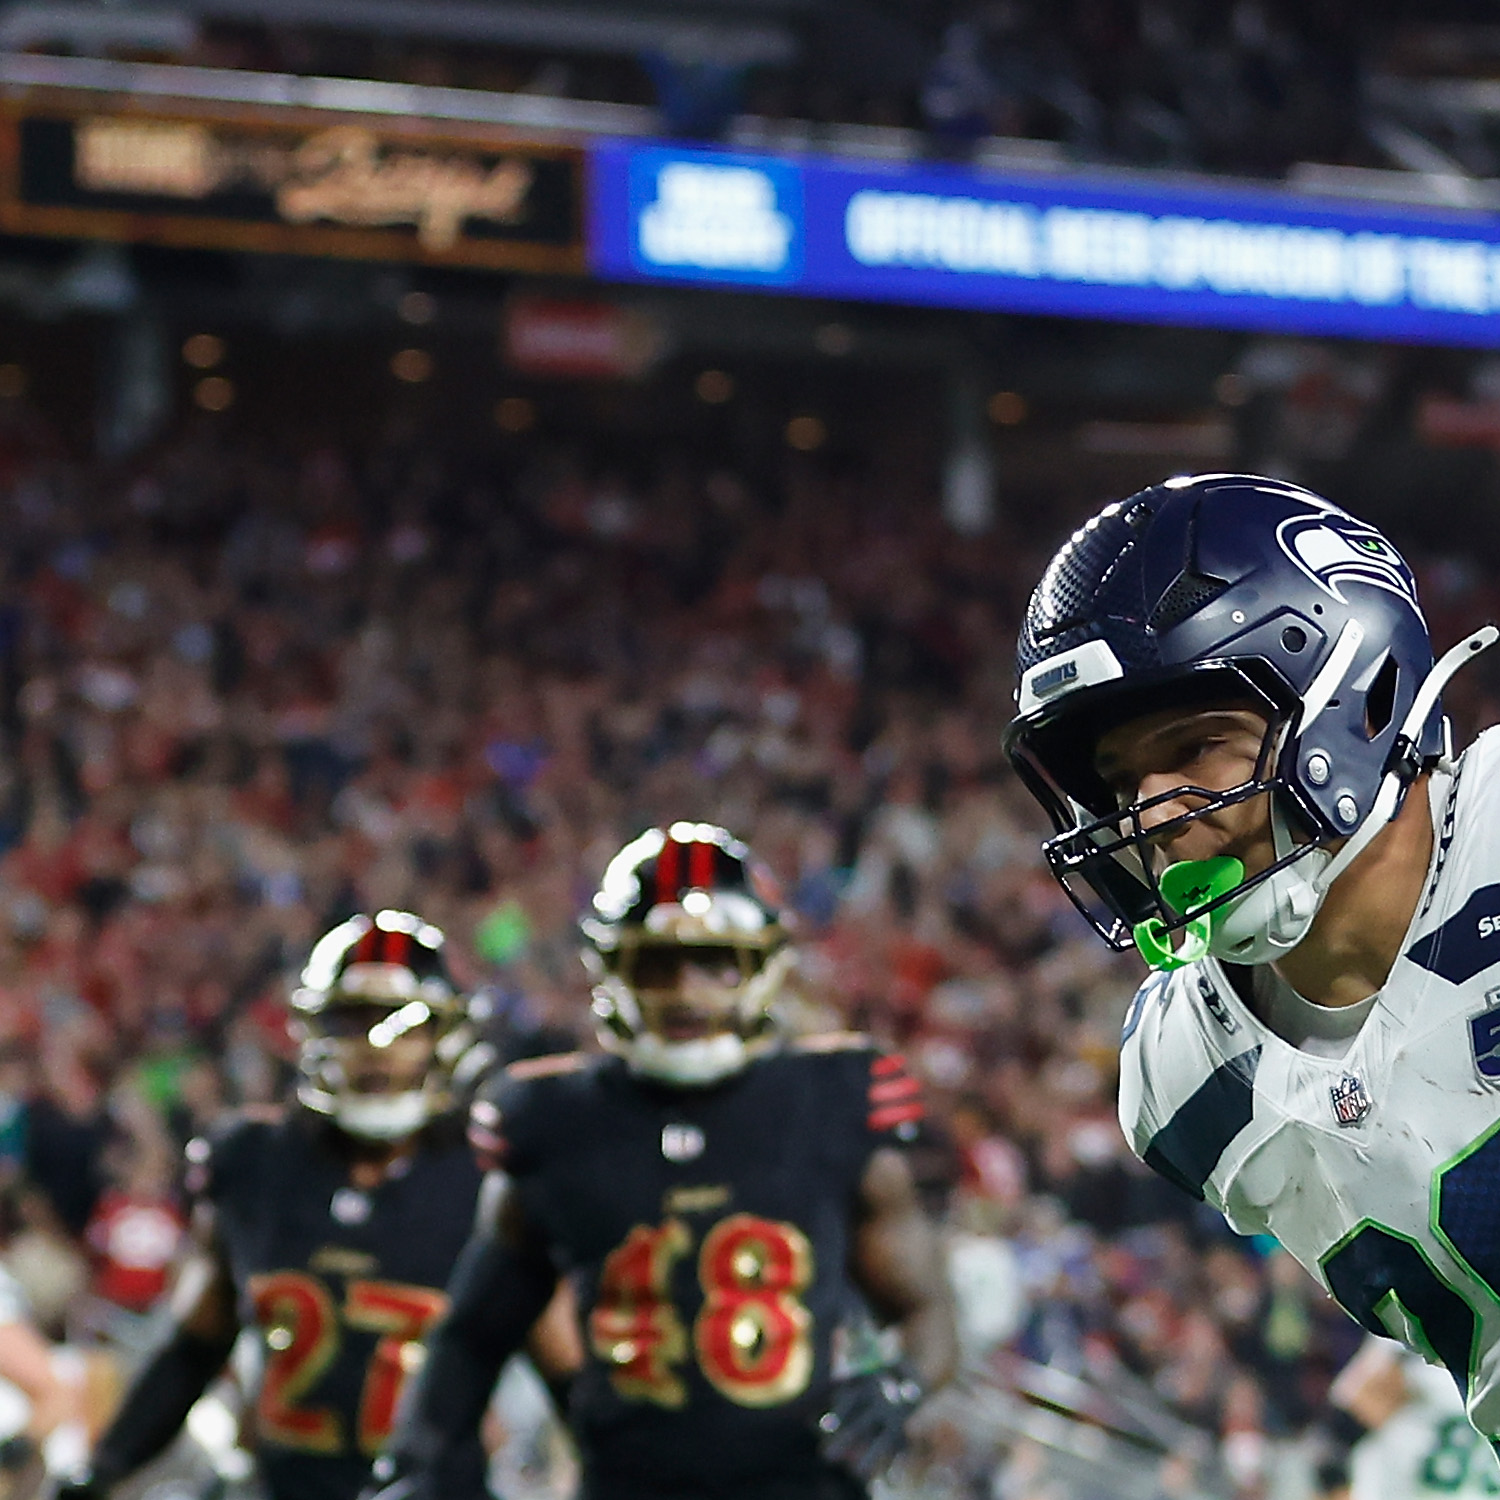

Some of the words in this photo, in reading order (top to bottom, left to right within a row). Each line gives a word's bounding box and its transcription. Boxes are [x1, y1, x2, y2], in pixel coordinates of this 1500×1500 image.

[1336, 1091, 1367, 1121] NFL
[250, 1271, 449, 1458] 27
[591, 1212, 813, 1407] 48
